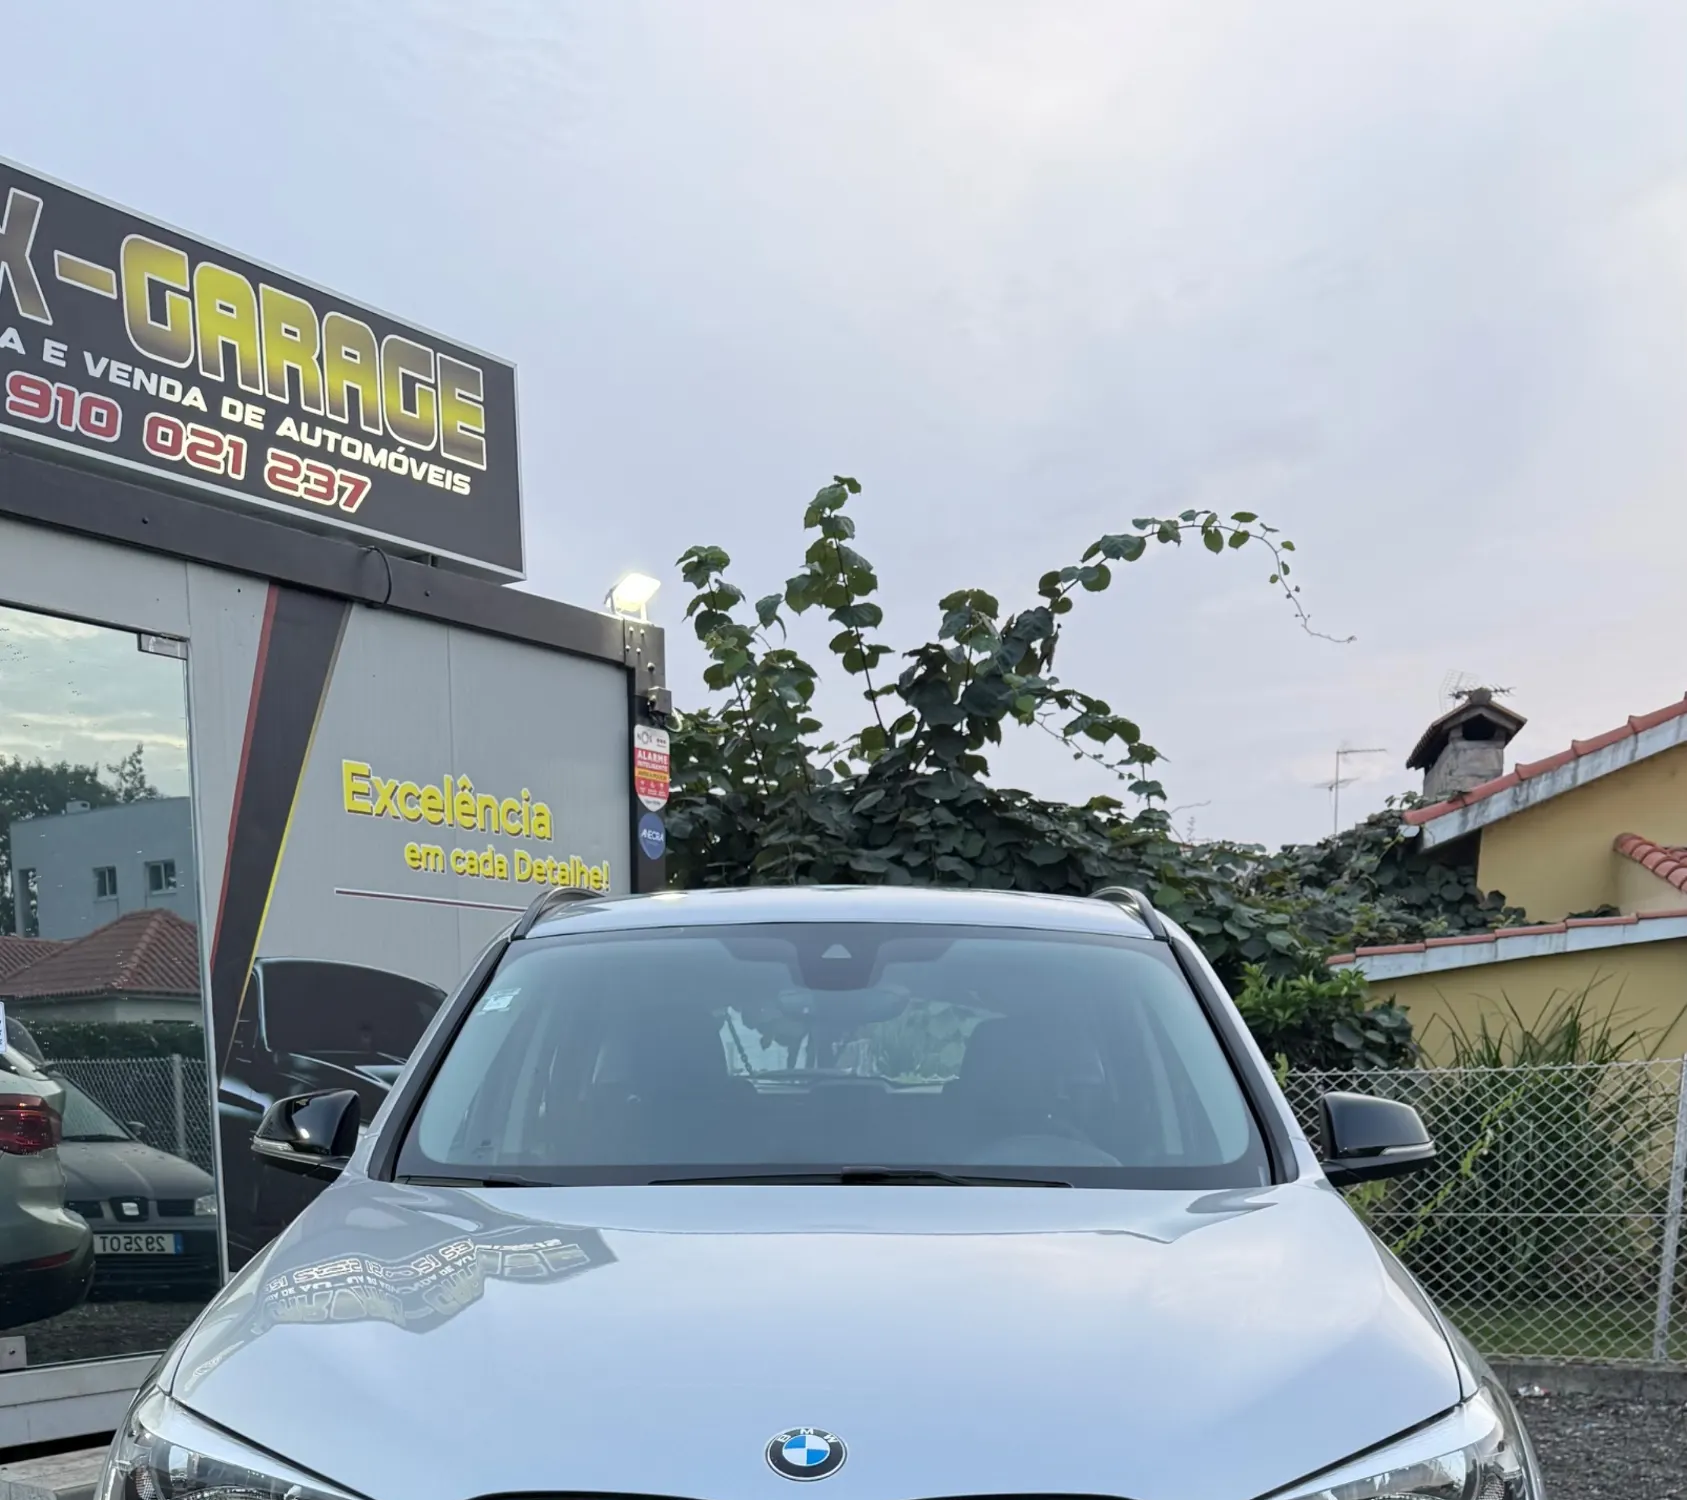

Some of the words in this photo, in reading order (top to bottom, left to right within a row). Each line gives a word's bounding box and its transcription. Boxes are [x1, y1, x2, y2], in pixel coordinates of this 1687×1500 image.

[6, 370, 122, 442] 910
[143, 412, 247, 481] 021
[263, 447, 371, 513] 237
[42, 338, 68, 368] E
[83, 351, 207, 413] VENDA
[221, 396, 265, 430] DE
[276, 417, 471, 496] AUTOMÓVEIS
[637, 749, 668, 765] ALARME
[342, 759, 553, 842] Excelência
[405, 841, 446, 873] em
[450, 844, 508, 881] cada
[514, 848, 610, 891] Detalhe!
[776, 1427, 839, 1443] BMW
